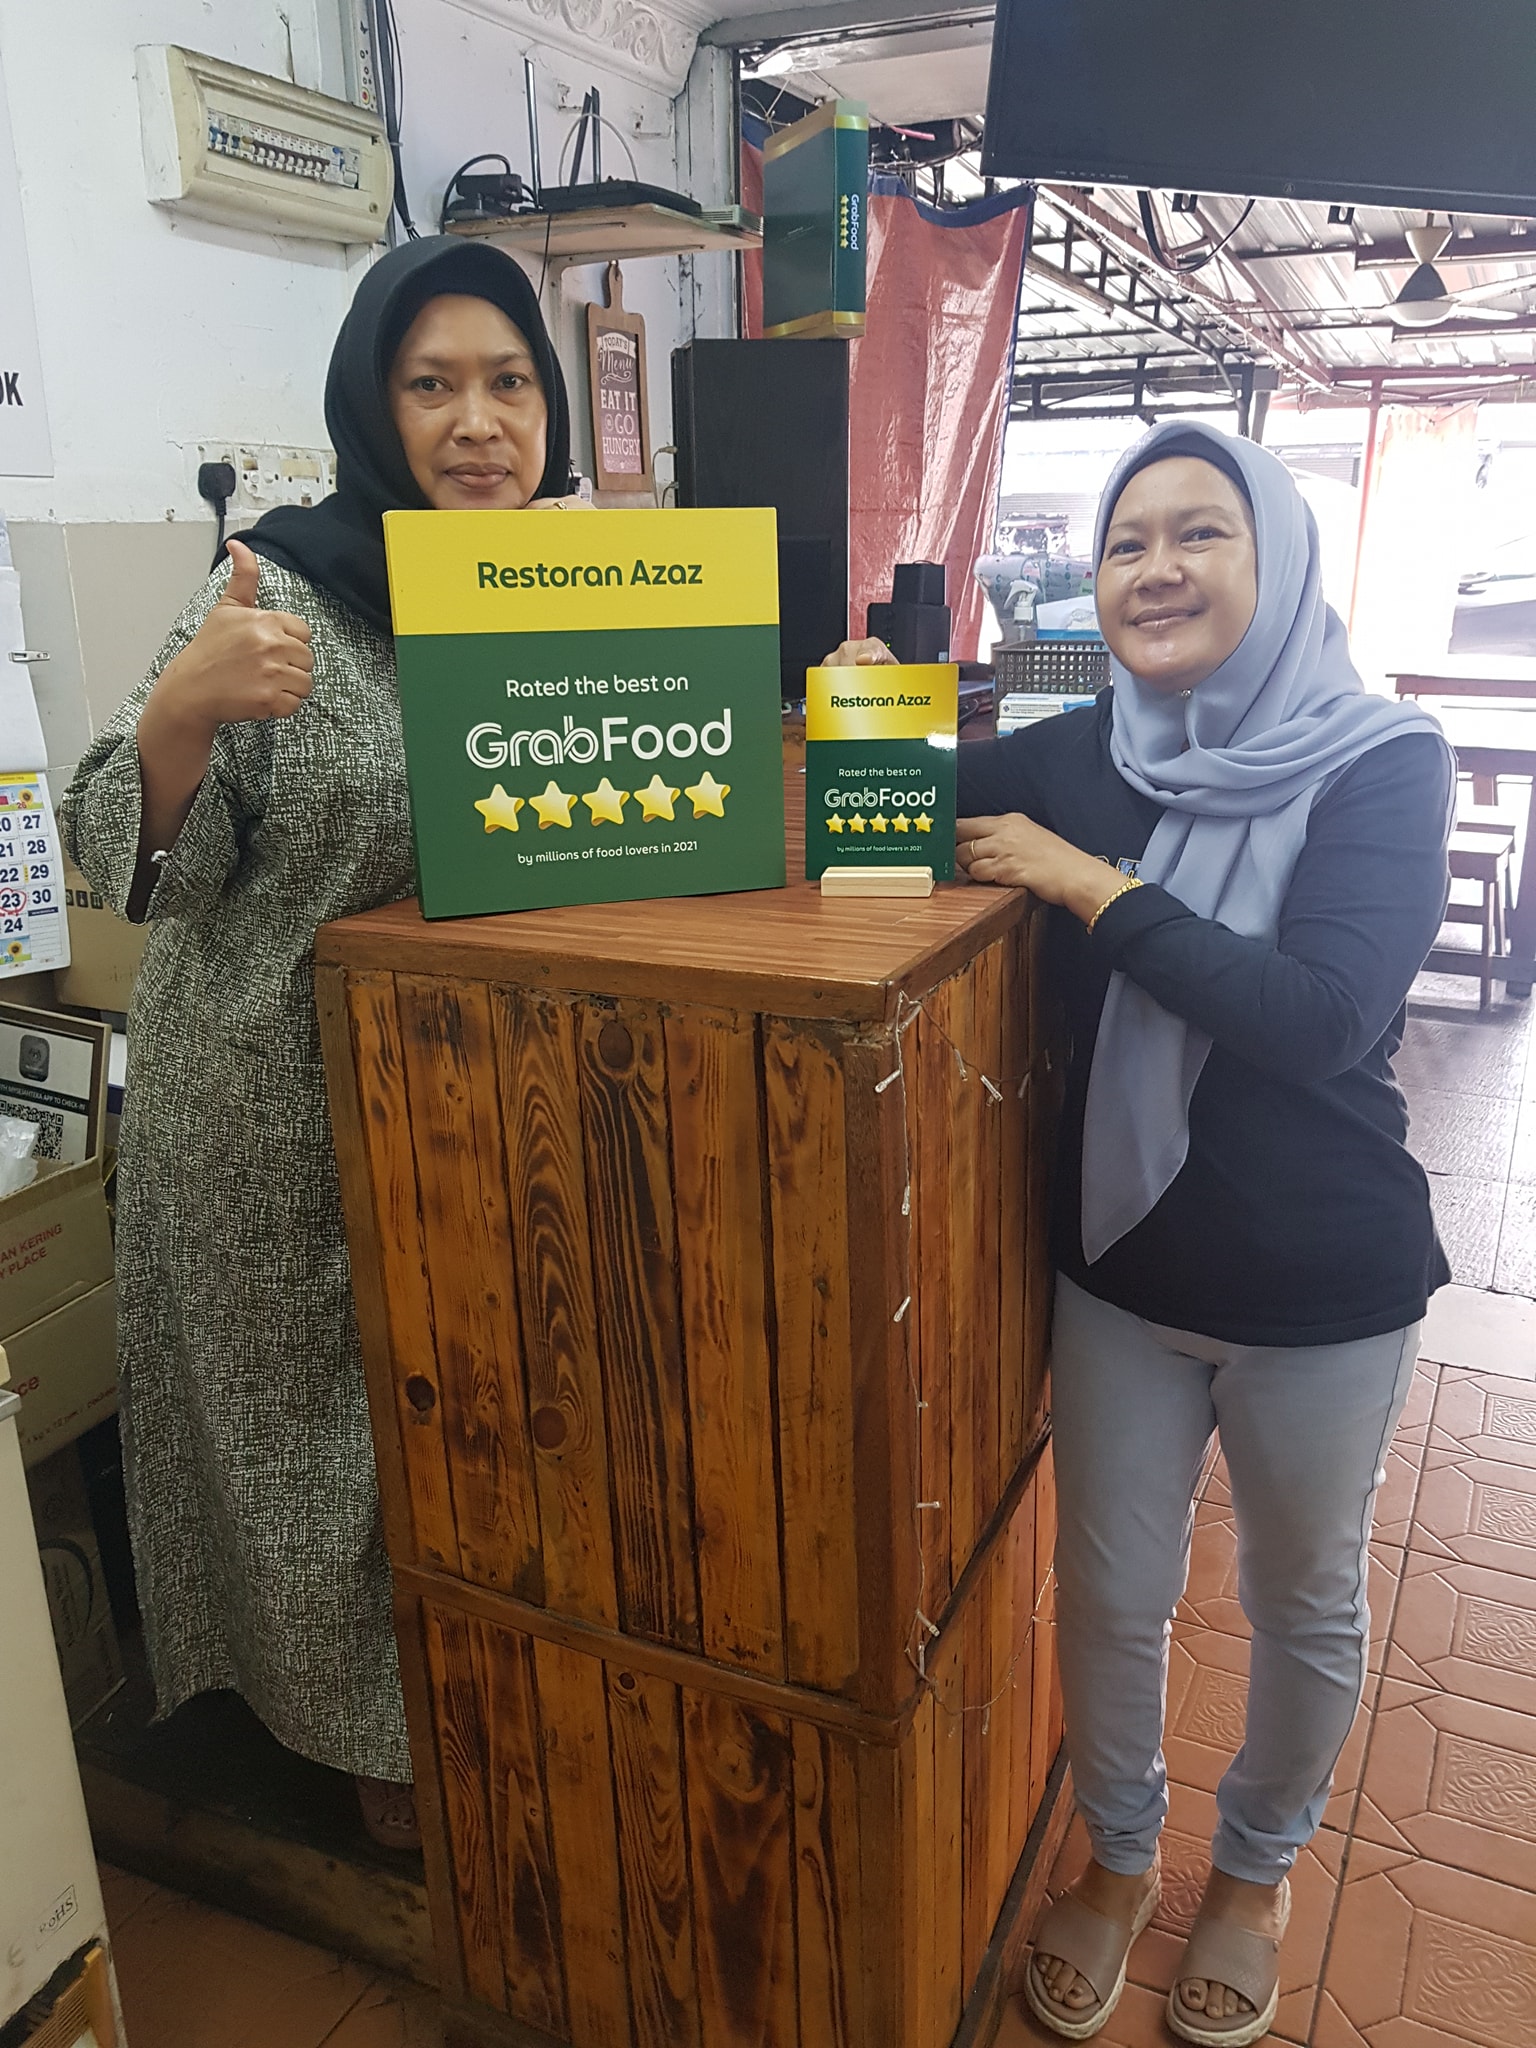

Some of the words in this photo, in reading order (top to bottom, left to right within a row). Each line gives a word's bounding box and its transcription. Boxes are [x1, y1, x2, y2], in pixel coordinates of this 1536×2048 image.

[851, 194, 859, 250] GrabFood
[604, 335, 628, 350] TODAY'S
[598, 348, 633, 374] Menu
[0, 371, 24, 407] K
[600, 388, 620, 410] EAT
[624, 391, 636, 411] IT
[614, 413, 634, 435] GO
[602, 436, 640, 456] HUNGRY
[477, 561, 623, 589] Restoran
[629, 559, 703, 586] Azaz
[505, 676, 569, 698] Rated
[574, 676, 609, 695] the
[613, 675, 659, 694] best
[663, 676, 689, 692] on
[830, 695, 895, 708] Restoran
[896, 694, 931, 706] Azaz
[465, 707, 732, 769] GrabFood
[838, 767, 867, 777] Rated
[868, 767, 885, 777] the
[886, 767, 908, 777] best
[909, 768, 922, 776] on
[824, 786, 936, 808] GrabFood
[0, 817, 11, 832] 0
[22, 814, 41, 830] 27
[0, 842, 14, 857] 21
[27, 839, 47, 855] 28
[517, 853, 533, 865] by
[535, 851, 579, 863] millions
[582, 848, 594, 859] of
[596, 846, 623, 858] food
[625, 844, 659, 856] lovers
[661, 843, 672, 853] in
[673, 840, 698, 852] 2021
[0, 867, 19, 883] 22
[30, 864, 49, 880] 29
[1, 893, 20, 908] 23
[32, 888, 52, 904] 30
[4, 917, 23, 934] 24
[43, 1094, 54, 1102] APP
[19, 1223, 62, 1253] KERING
[9, 1246, 47, 1275] PLACE
[12, 1376, 39, 1397] ce
